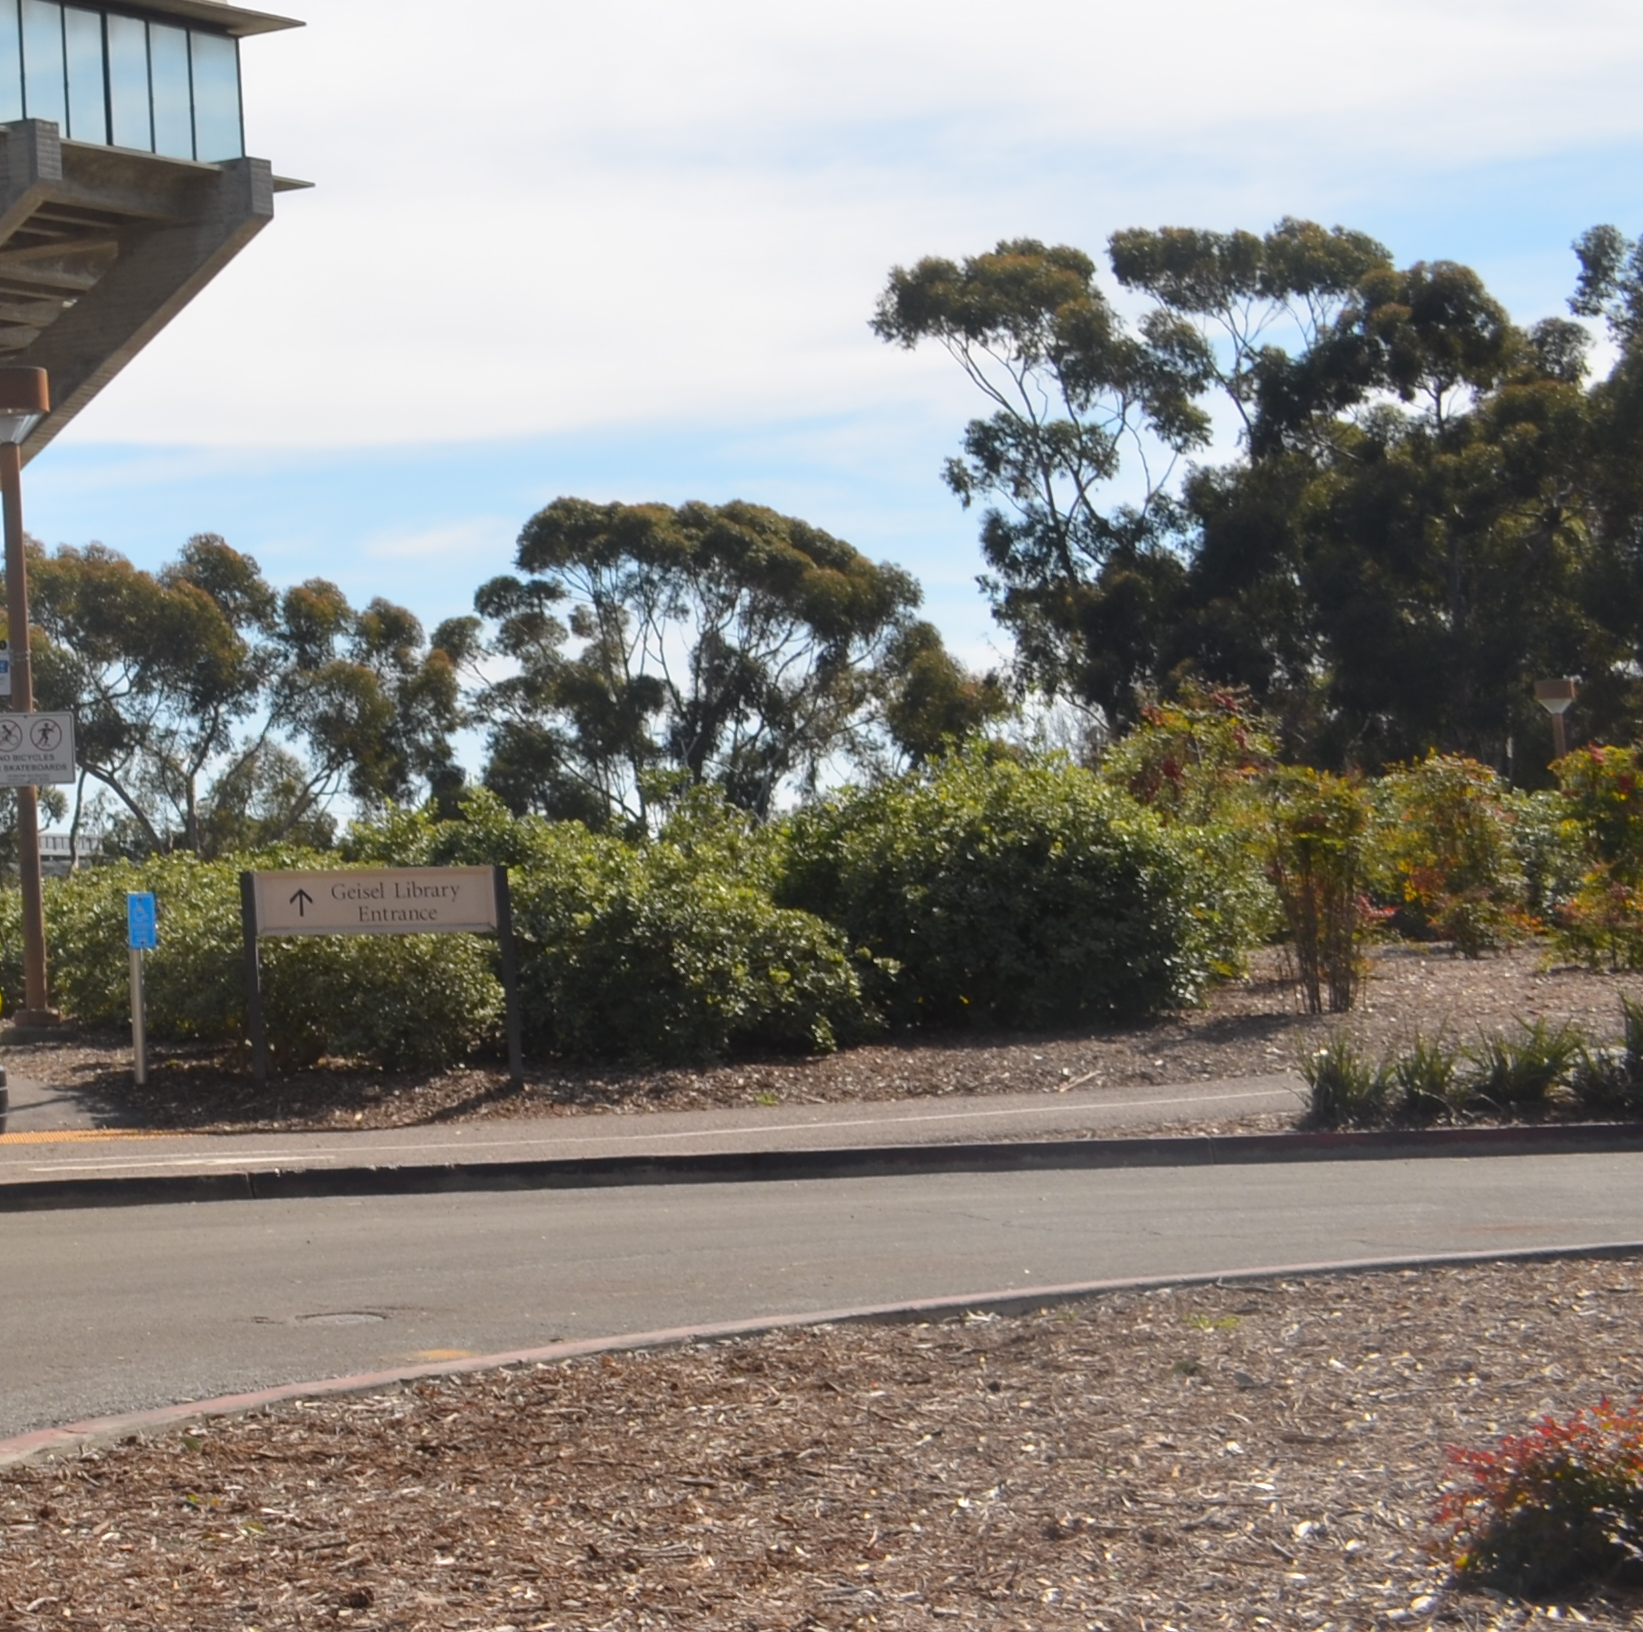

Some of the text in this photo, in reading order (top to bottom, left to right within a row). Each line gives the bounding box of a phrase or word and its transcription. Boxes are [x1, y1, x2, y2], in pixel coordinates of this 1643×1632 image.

[12, 753, 56, 762] BICYCLES
[3, 762, 68, 772] SKATEBOARDS
[331, 881, 461, 903] Geisel Library
[358, 906, 438, 923] Entrance
